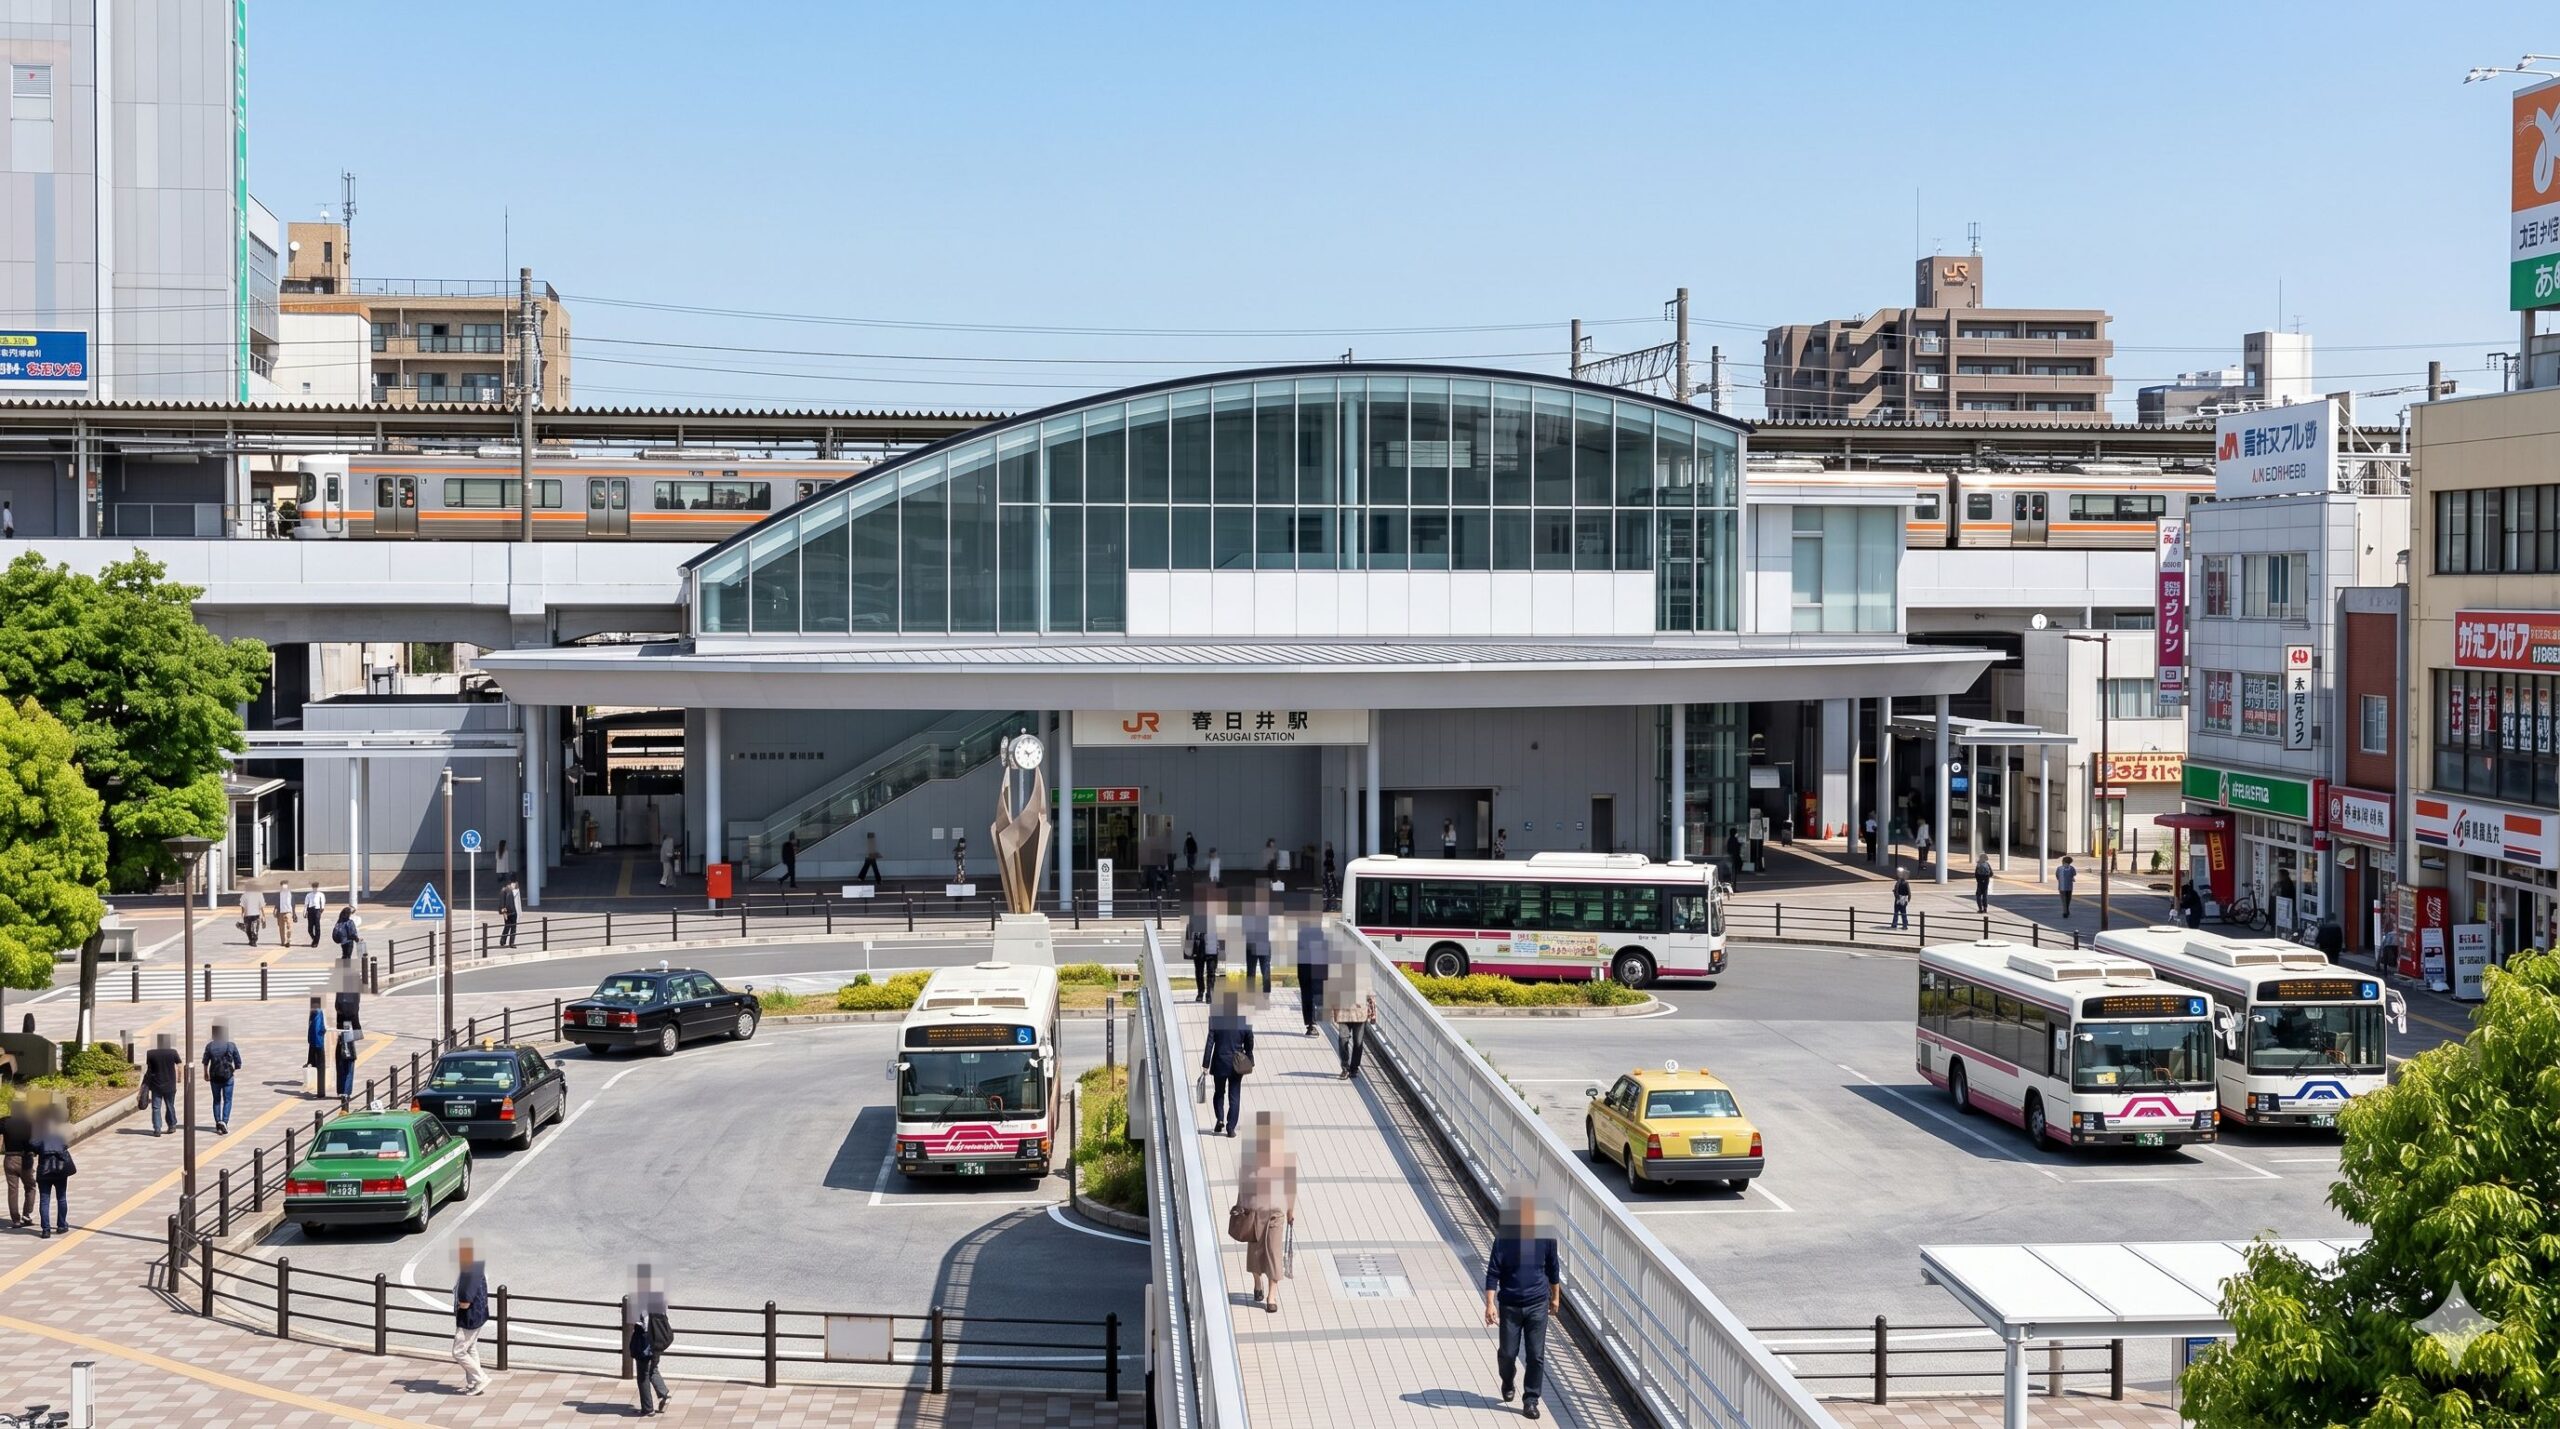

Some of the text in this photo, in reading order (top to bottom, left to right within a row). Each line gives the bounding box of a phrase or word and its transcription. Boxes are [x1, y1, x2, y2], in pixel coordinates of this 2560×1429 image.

[1123, 712, 1159, 732] JR
[1192, 711, 1308, 730] 春日井駅
[1205, 732, 1295, 742] KASUGAI STATION
